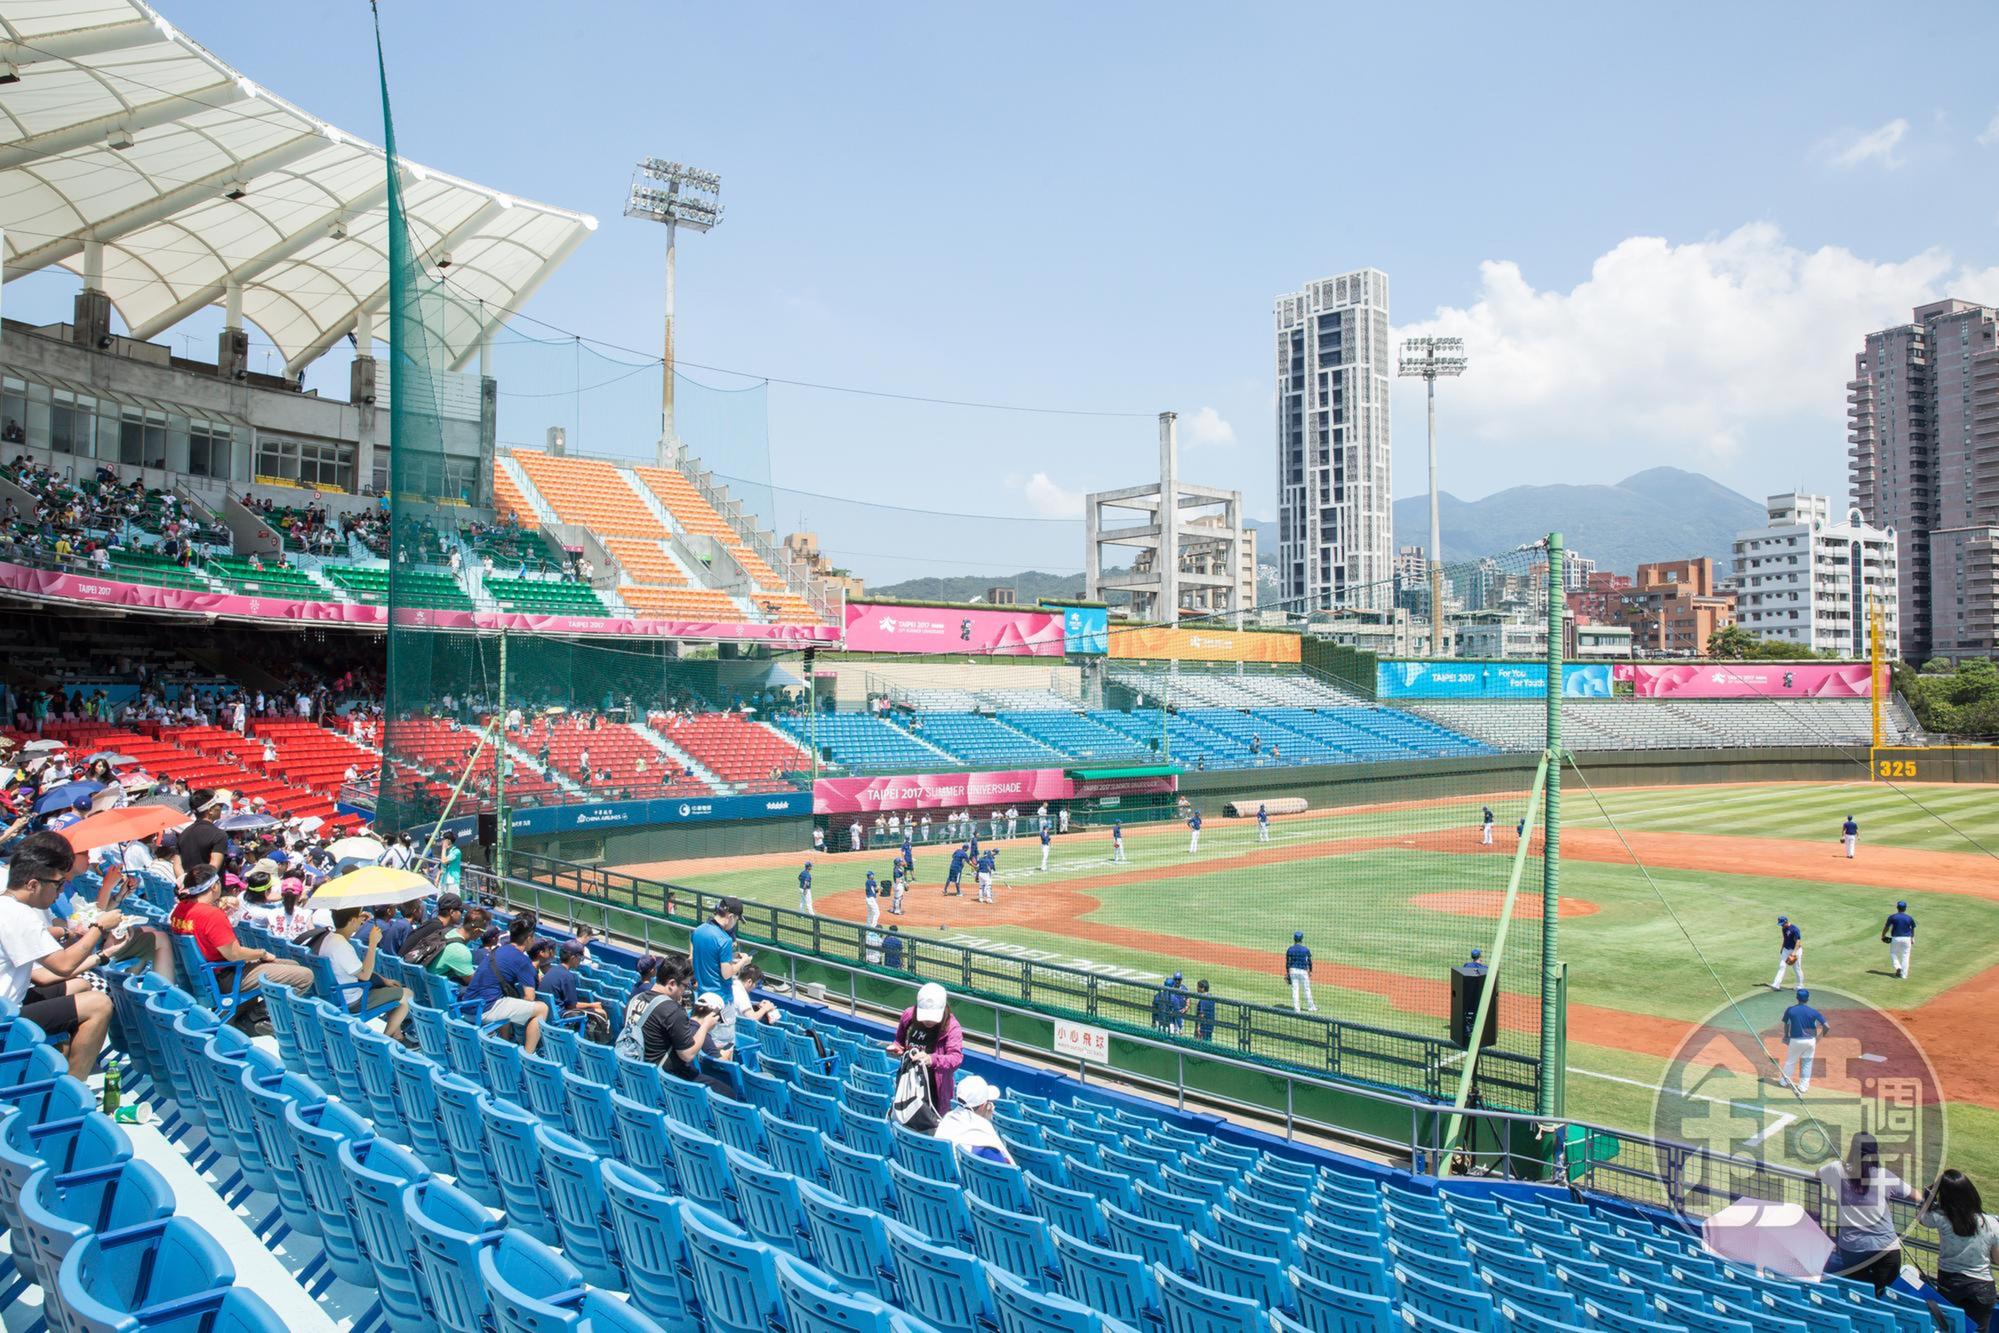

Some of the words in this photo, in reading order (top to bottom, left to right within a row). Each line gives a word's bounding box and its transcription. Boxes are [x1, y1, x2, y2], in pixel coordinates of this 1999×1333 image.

[78, 583, 97, 594] TAIPEI
[98, 585, 111, 596] 2017
[590, 621, 604, 629] 2017
[1432, 673, 1456, 682] TAIPEI
[1458, 674, 1475, 682] 2017
[1498, 668, 1511, 677] For
[1511, 669, 1526, 677] You
[1510, 679, 1523, 687] For
[1523, 678, 1545, 687] Youth
[1880, 760, 1917, 777] 325
[867, 788, 899, 801] TAIPEI
[902, 787, 923, 799] 2017
[926, 785, 964, 798] SUMMER
[967, 782, 1022, 794] UNIVERSIADE
[1057, 1026, 1104, 1049] 小心飛球
